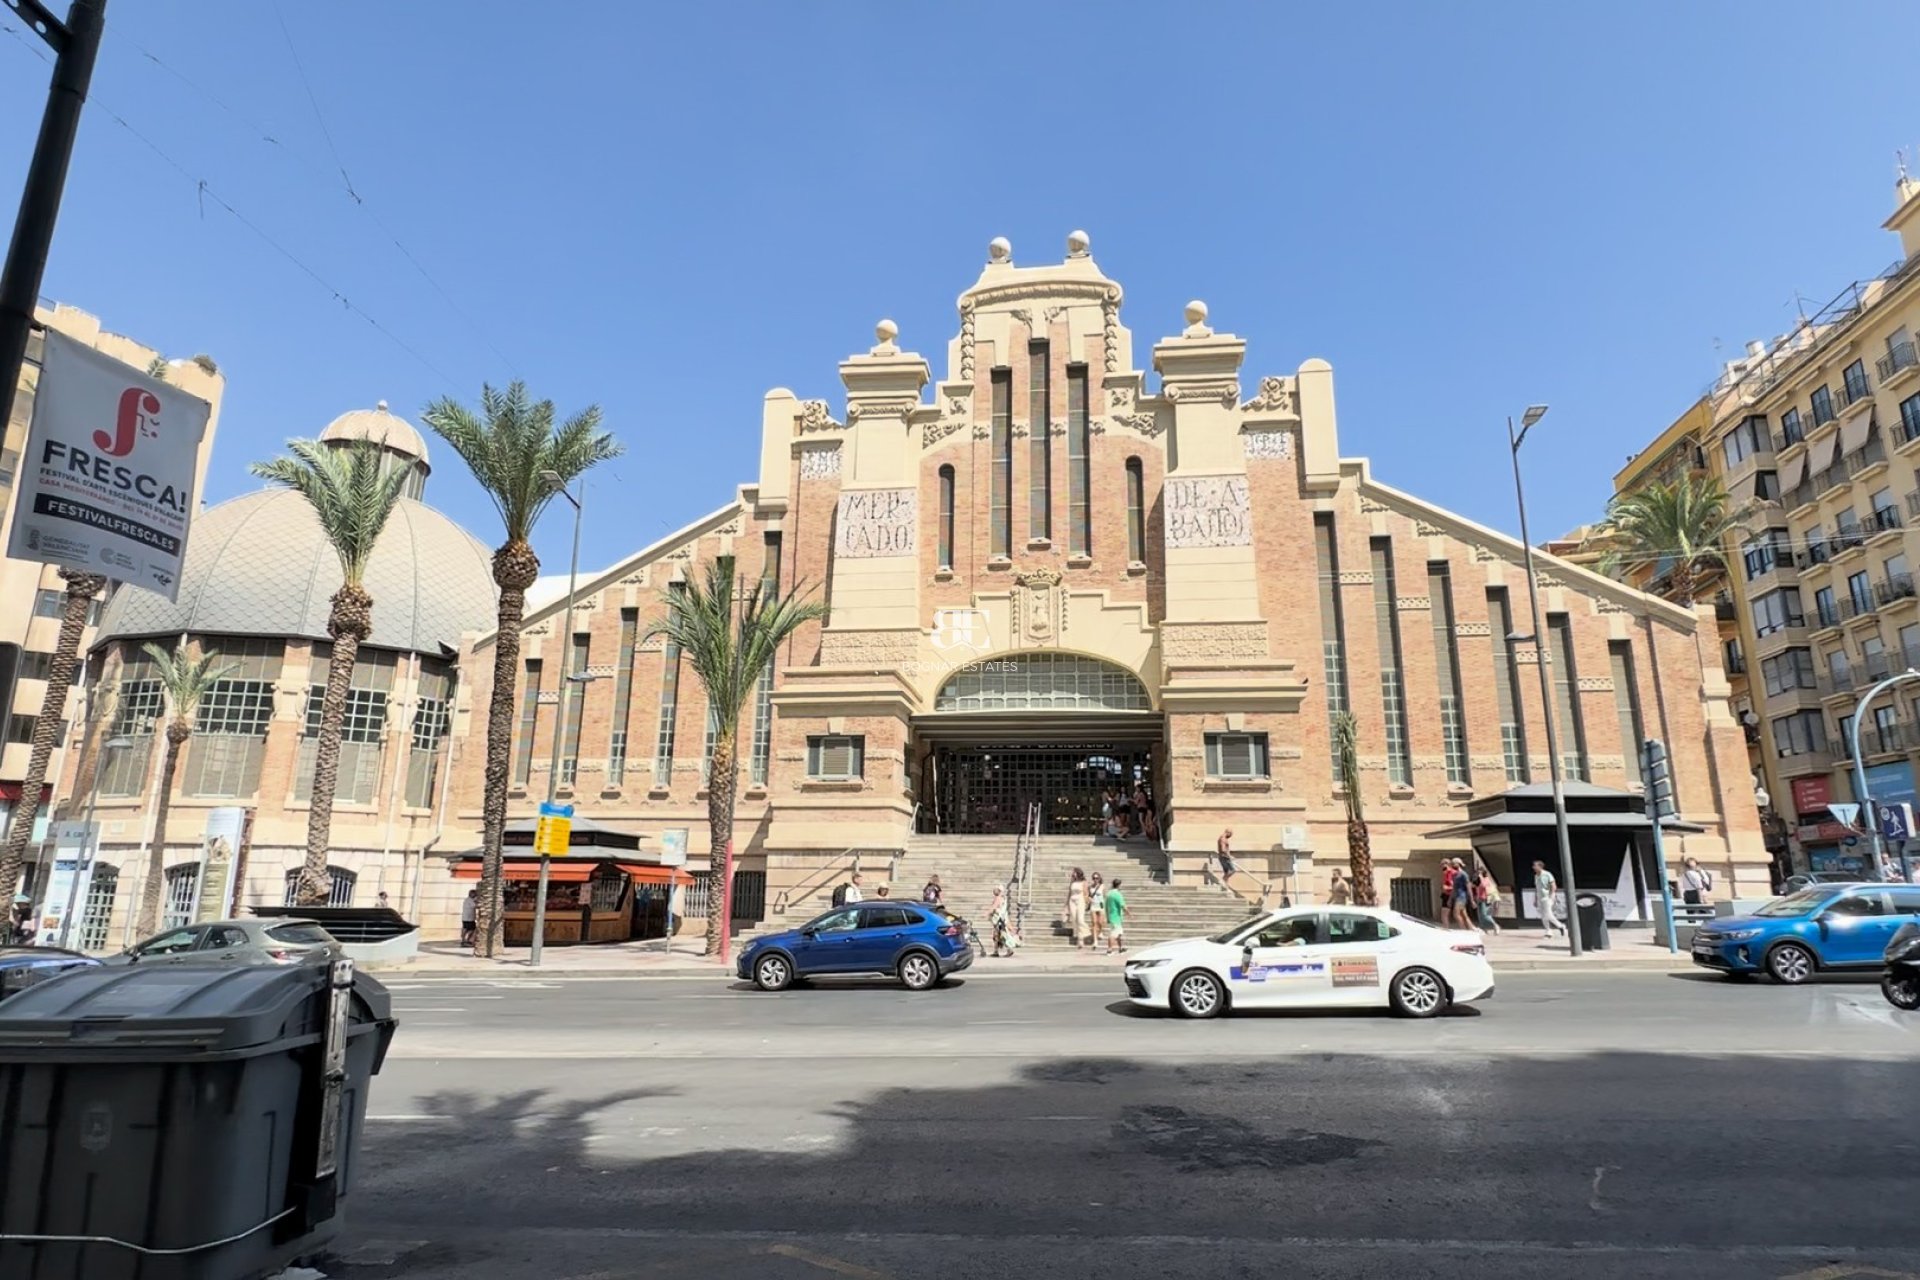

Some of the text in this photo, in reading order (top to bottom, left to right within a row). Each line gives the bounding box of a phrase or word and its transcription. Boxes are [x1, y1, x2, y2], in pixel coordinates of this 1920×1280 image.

[39, 467, 80, 483] FESTIVAL
[82, 479, 107, 493] D'ARTS
[39, 478, 61, 487] CASA
[42, 439, 188, 514] FRESCA!
[1171, 480, 1207, 509] DE
[48, 499, 175, 551] FESTIVALFRESCA.ES
[845, 525, 908, 551] CADO
